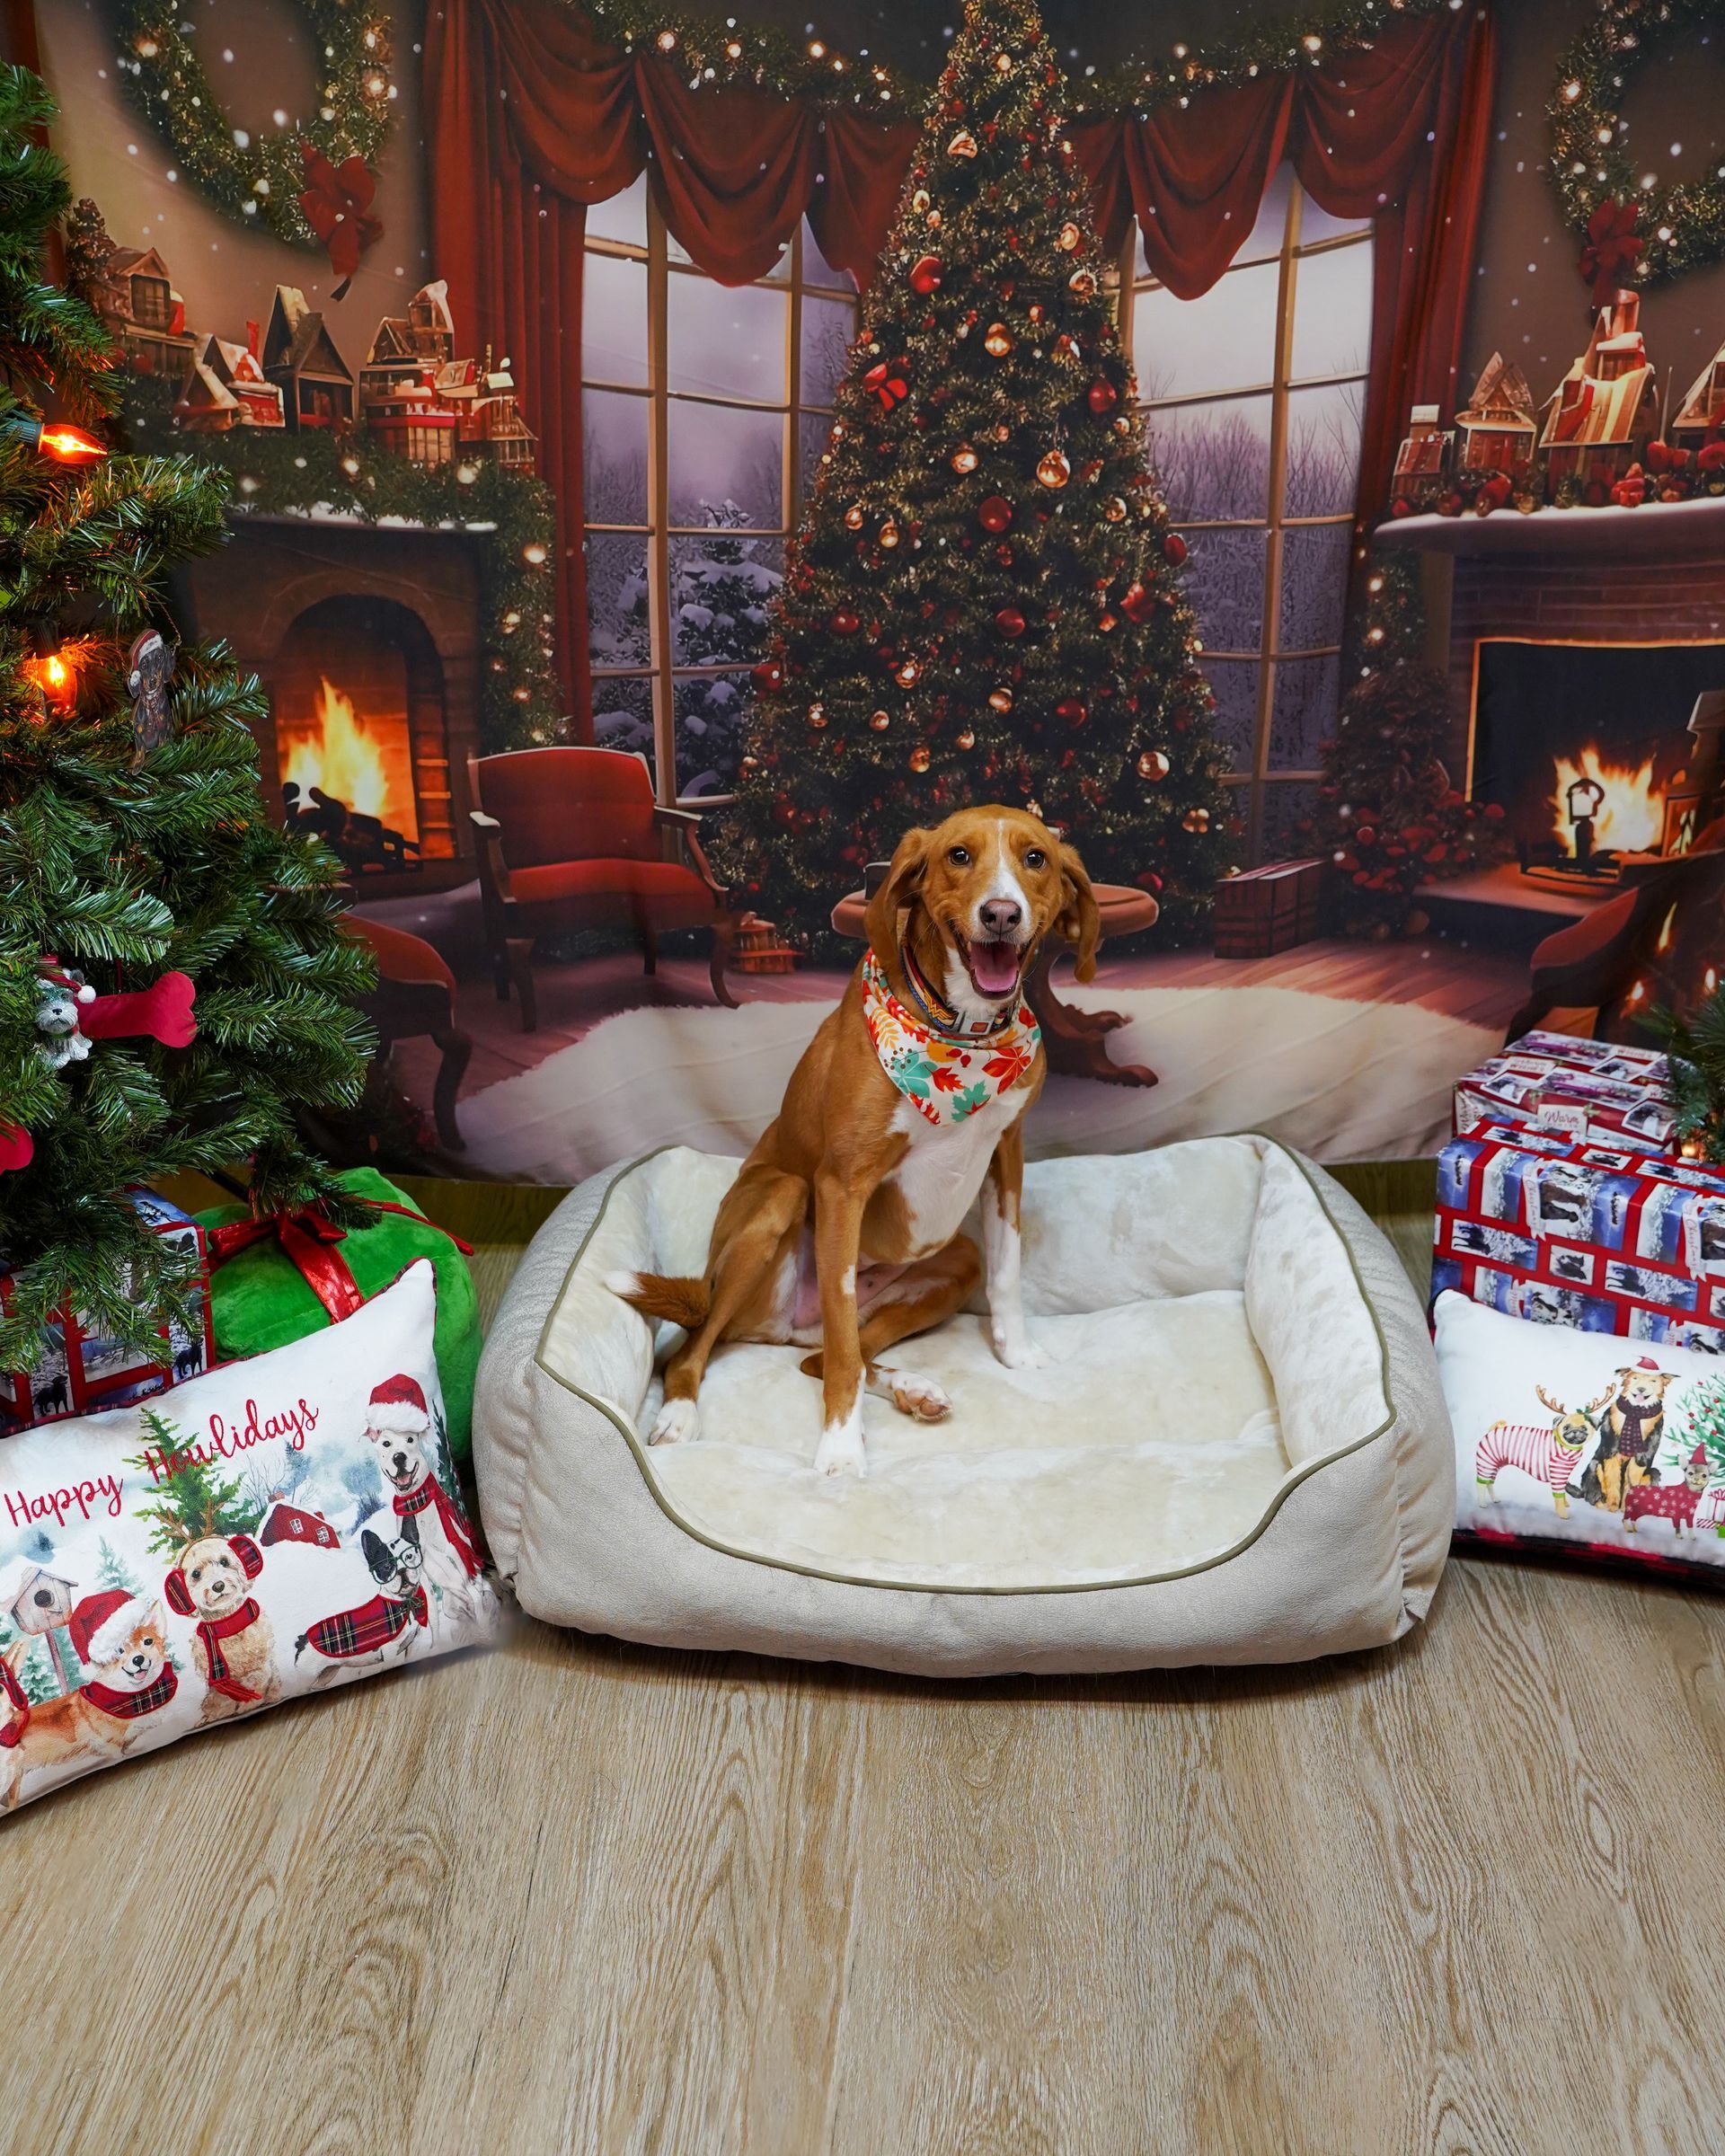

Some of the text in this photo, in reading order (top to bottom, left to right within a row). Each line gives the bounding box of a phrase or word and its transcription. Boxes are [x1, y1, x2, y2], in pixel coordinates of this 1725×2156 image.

[1544, 1110, 1579, 1124] Warm
[4, 1398, 320, 1527] Happy Howlidays
